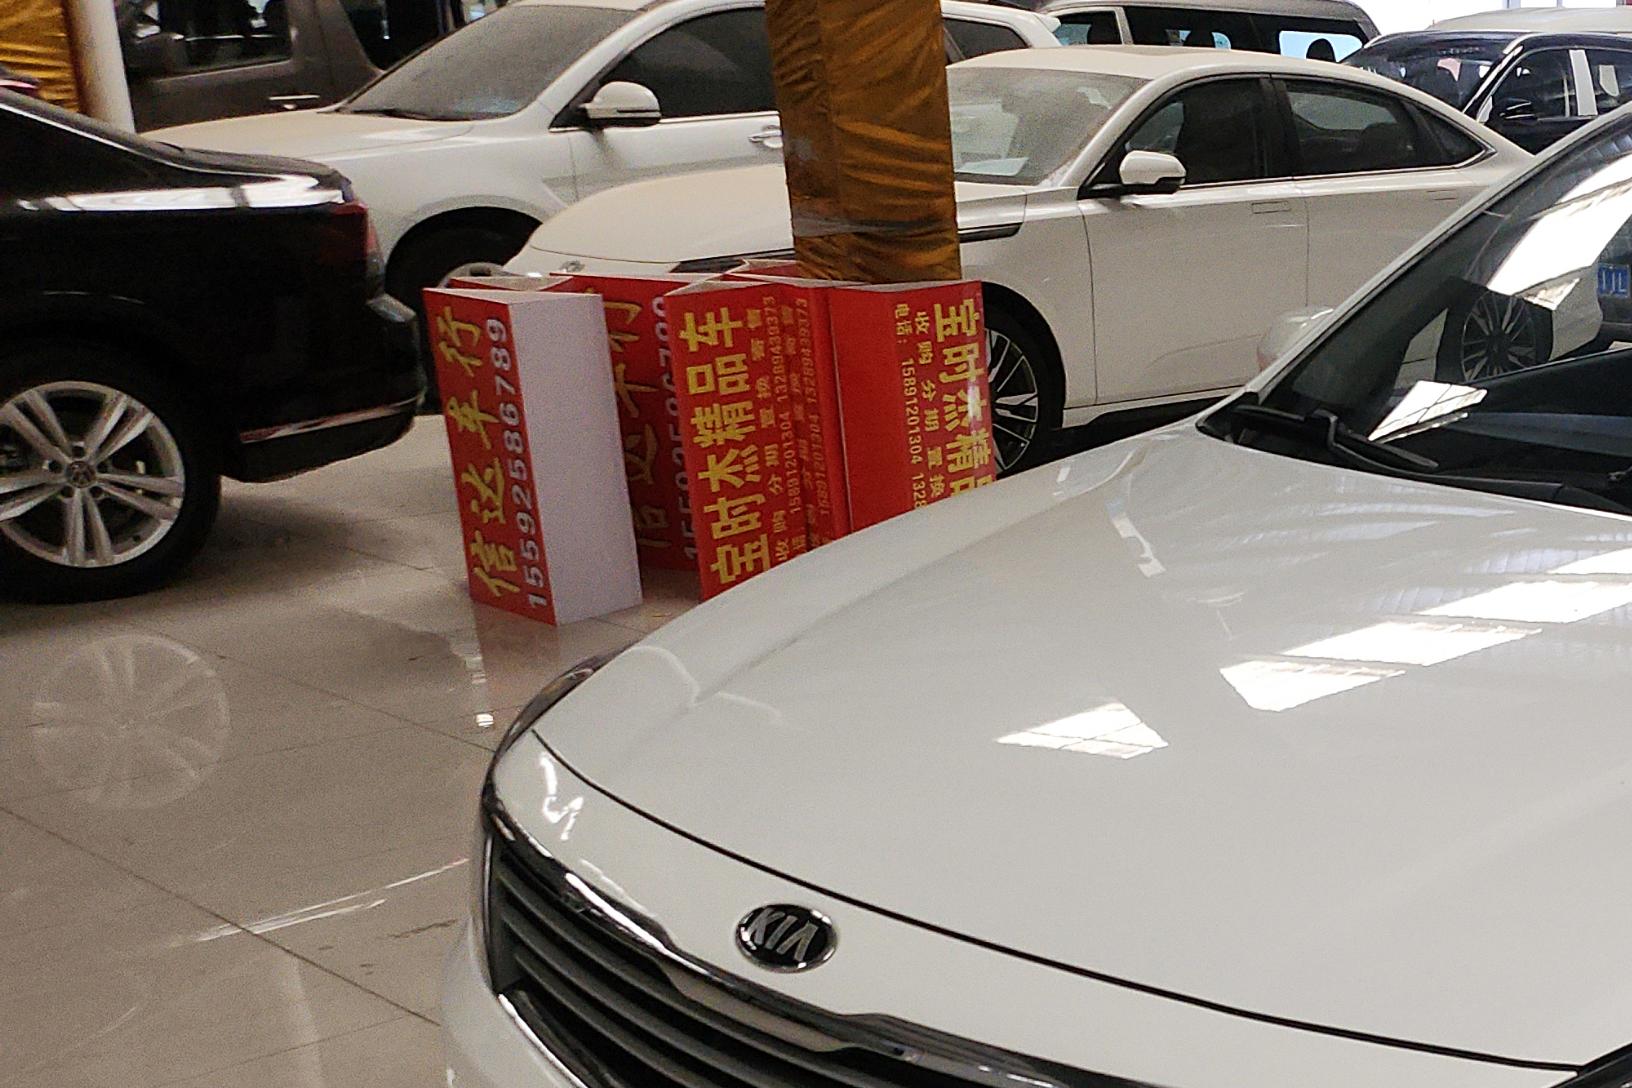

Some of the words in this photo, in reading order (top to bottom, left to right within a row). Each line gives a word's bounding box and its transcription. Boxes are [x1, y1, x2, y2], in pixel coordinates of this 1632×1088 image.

[915, 312, 934, 365] 收购
[679, 306, 771, 585] 宝时杰精品车
[901, 358, 923, 464] 15891201304
[921, 379, 940, 432] 分期
[436, 306, 520, 597] 信达车行
[486, 319, 548, 608] 15592586789
[927, 446, 945, 498] 置换
[747, 908, 819, 962] KIA
